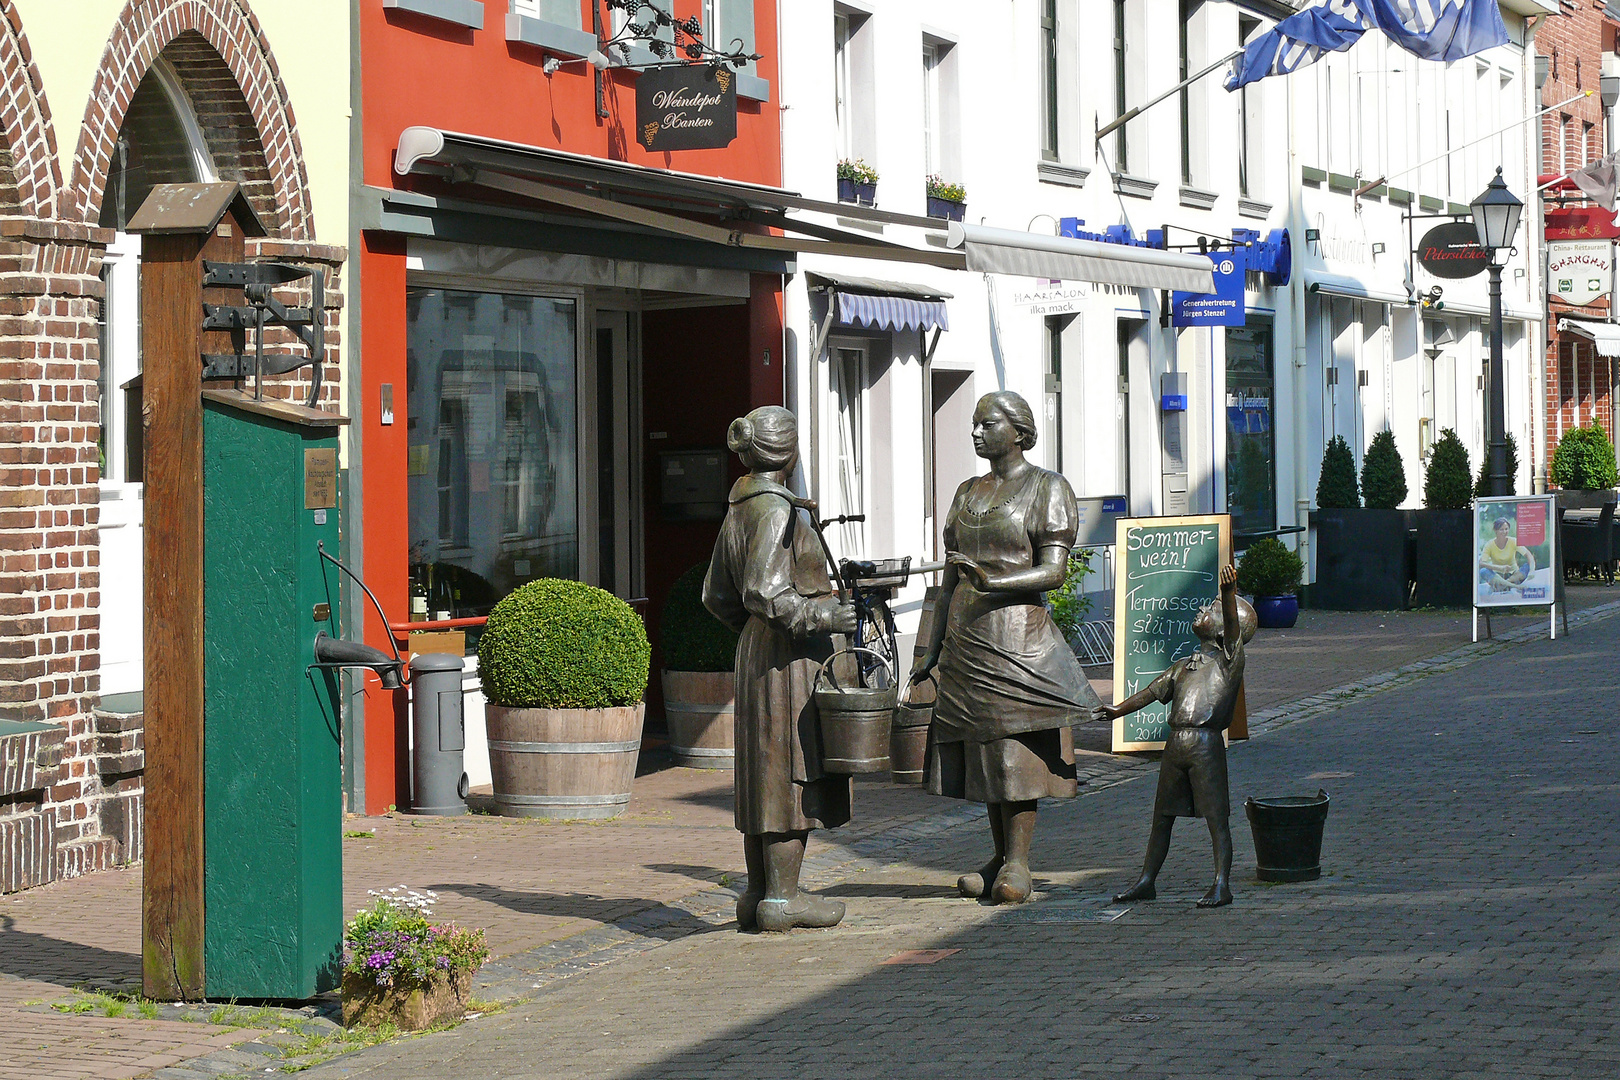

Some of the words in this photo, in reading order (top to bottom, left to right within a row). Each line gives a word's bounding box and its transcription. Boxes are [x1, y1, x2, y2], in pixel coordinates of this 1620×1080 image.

[652, 87, 721, 112] Weindepot
[661, 112, 714, 130] Xanten
[1550, 254, 1609, 272] SHANGHAI
[1014, 289, 1086, 304] HAARSALON
[1182, 299, 1236, 308] Generalvertretung
[1030, 305, 1046, 315] ilka
[1049, 301, 1074, 313] mack
[1182, 310, 1203, 318] Jürgen
[1203, 309, 1226, 317] Stenzel
[1127, 527, 1216, 550] Sommer-
[1133, 639, 1165, 654] 2012
[1135, 727, 1162, 741] 2011
